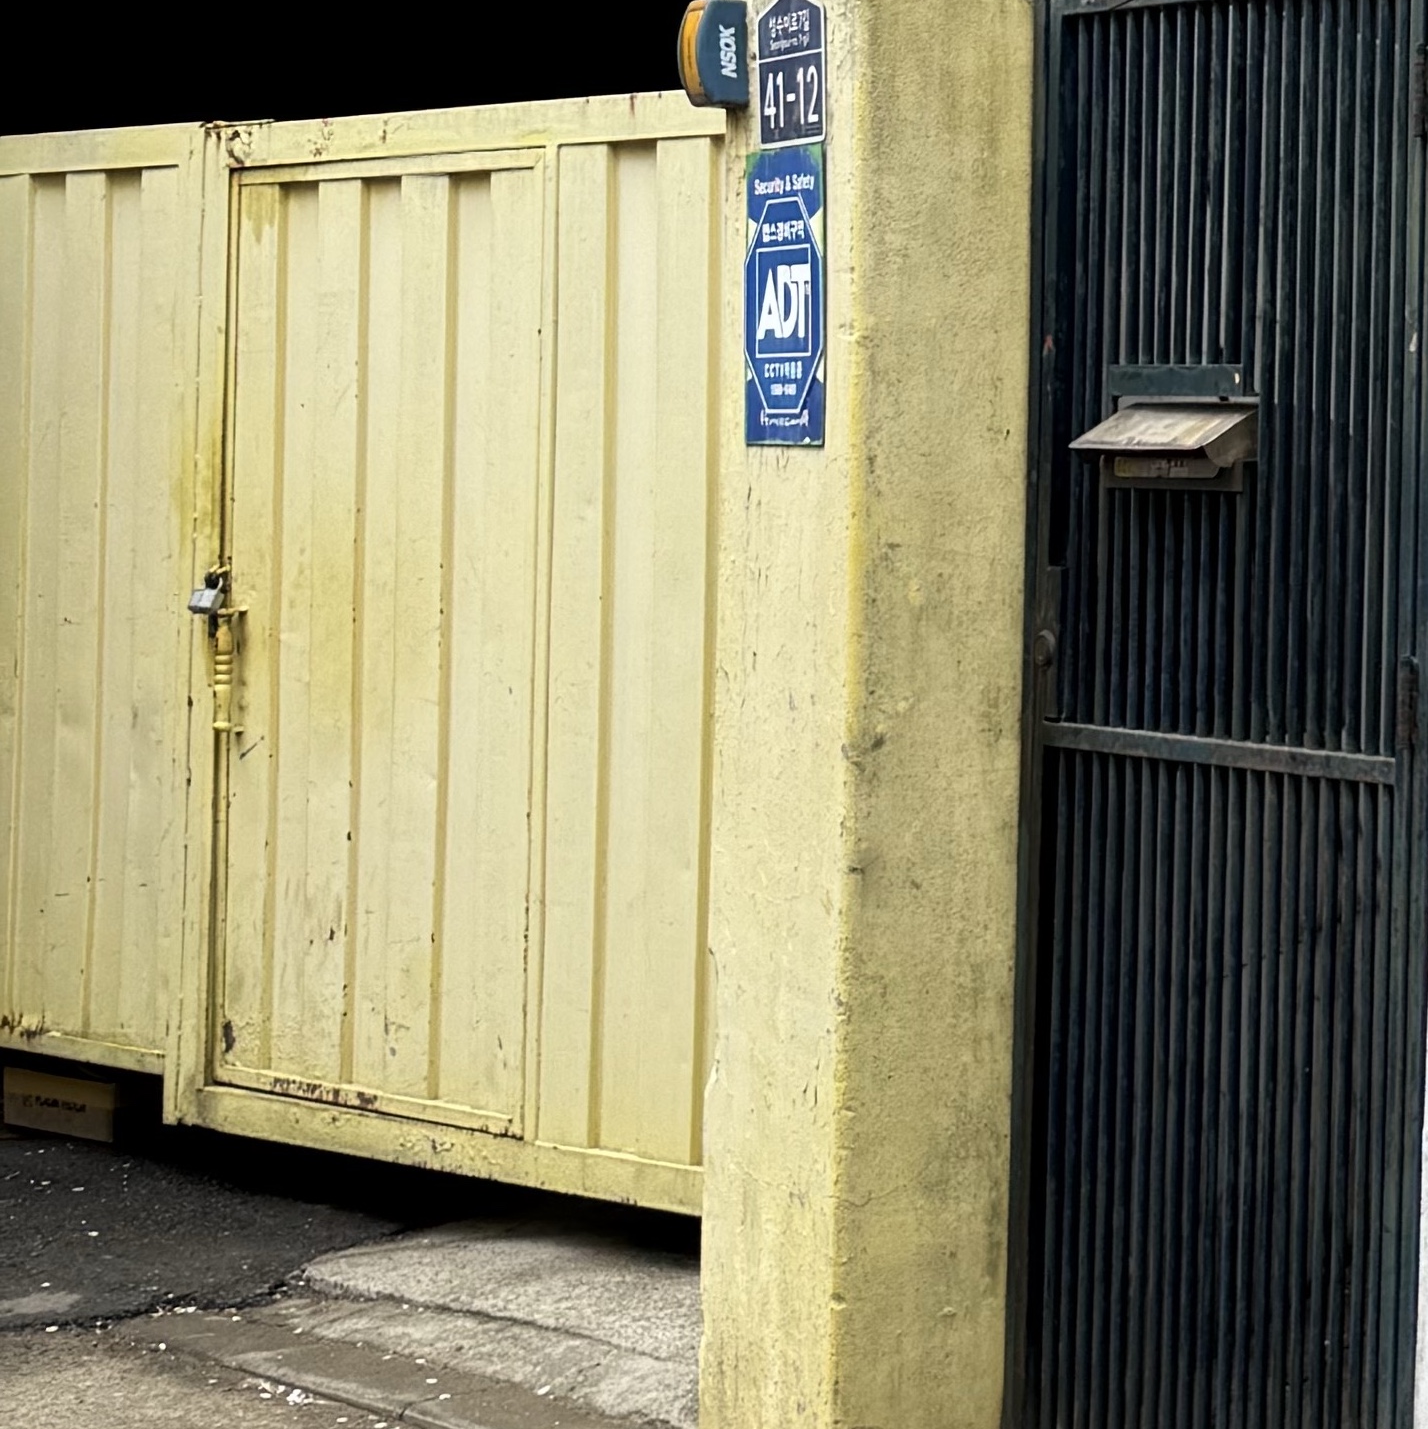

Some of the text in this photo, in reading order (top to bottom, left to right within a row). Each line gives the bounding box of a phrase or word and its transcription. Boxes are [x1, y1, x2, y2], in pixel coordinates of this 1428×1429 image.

[719, 24, 738, 79] NSOK
[764, 65, 819, 129] 41-12
[754, 173, 814, 195] Security & Safety
[757, 263, 811, 340] ADT
